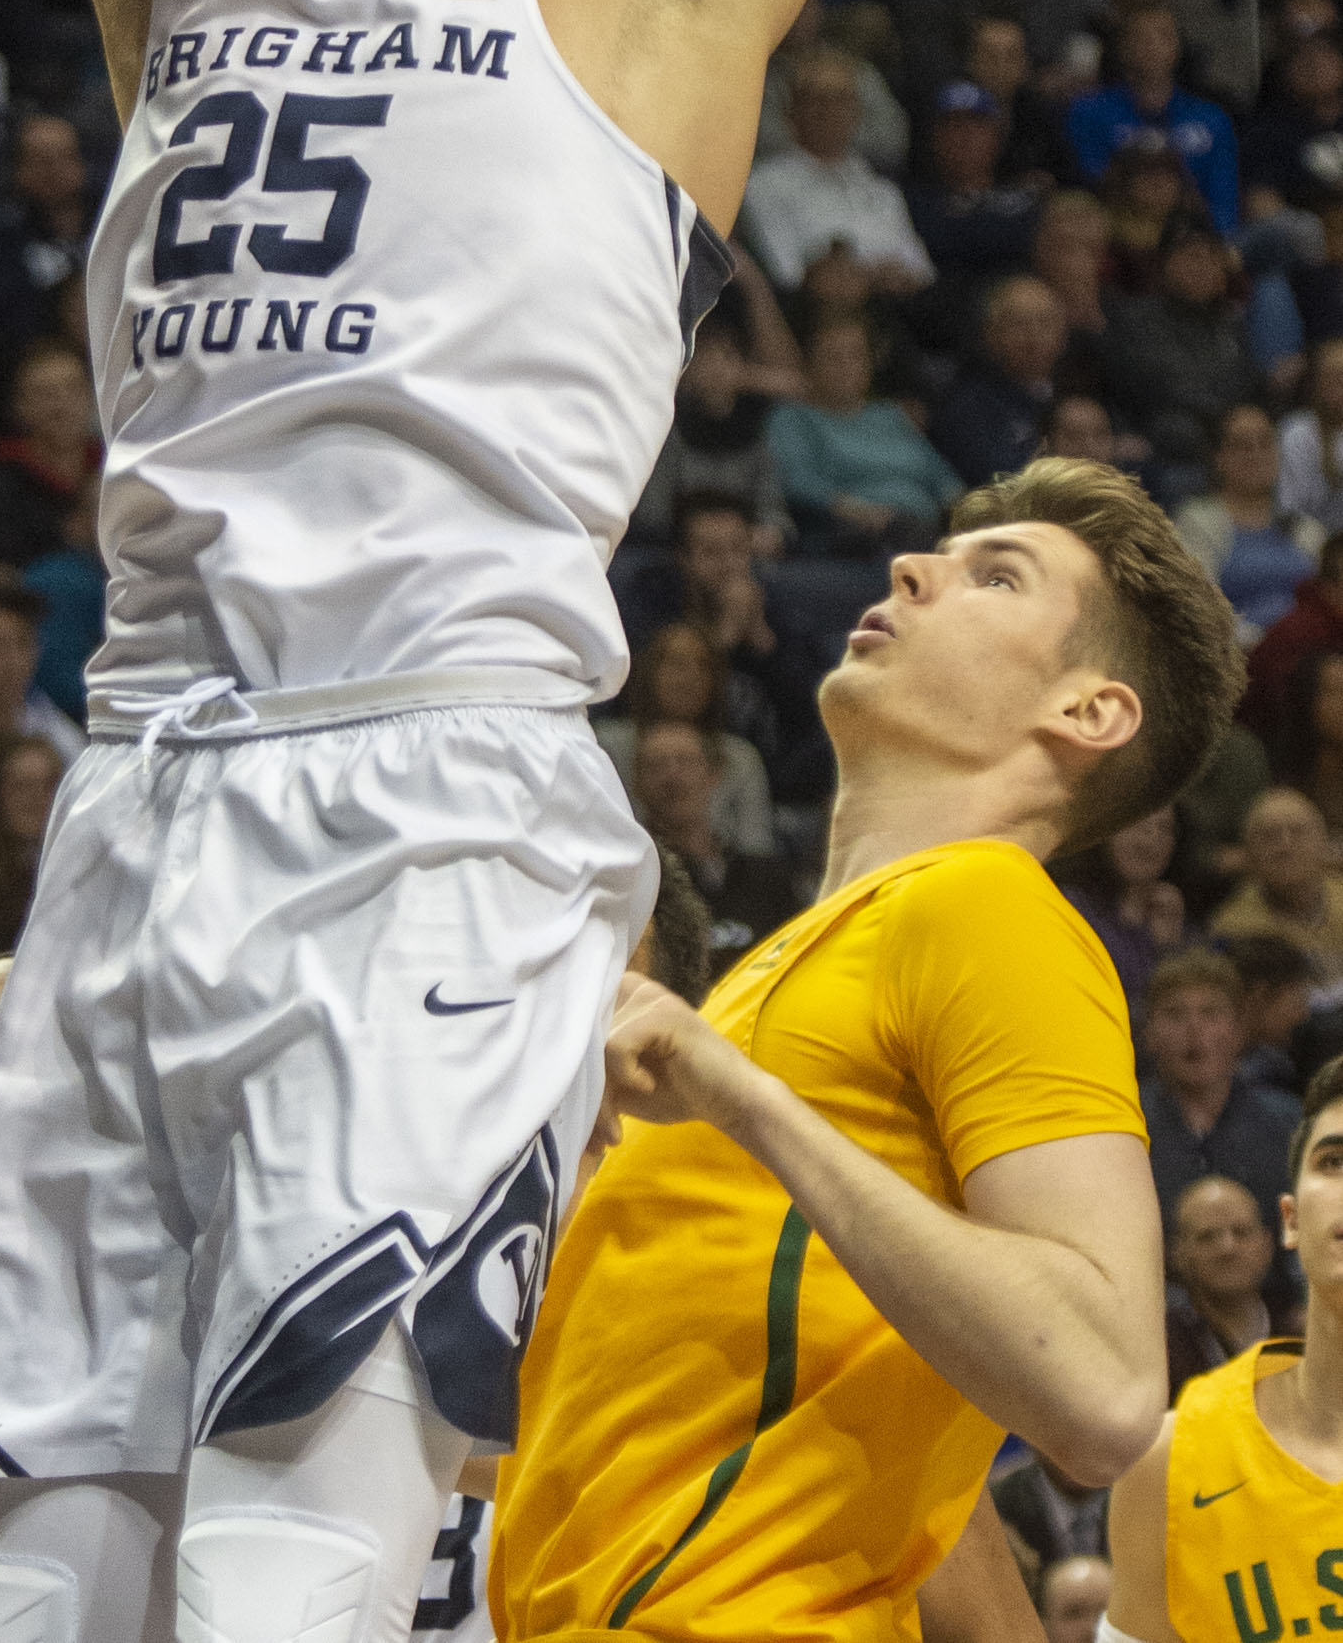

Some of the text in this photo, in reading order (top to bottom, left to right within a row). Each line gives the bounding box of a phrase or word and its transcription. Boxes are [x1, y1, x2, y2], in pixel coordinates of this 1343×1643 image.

[144, 22, 516, 104] BRIGHAM
[153, 90, 393, 284] 25
[132, 298, 377, 369] YOUNG
